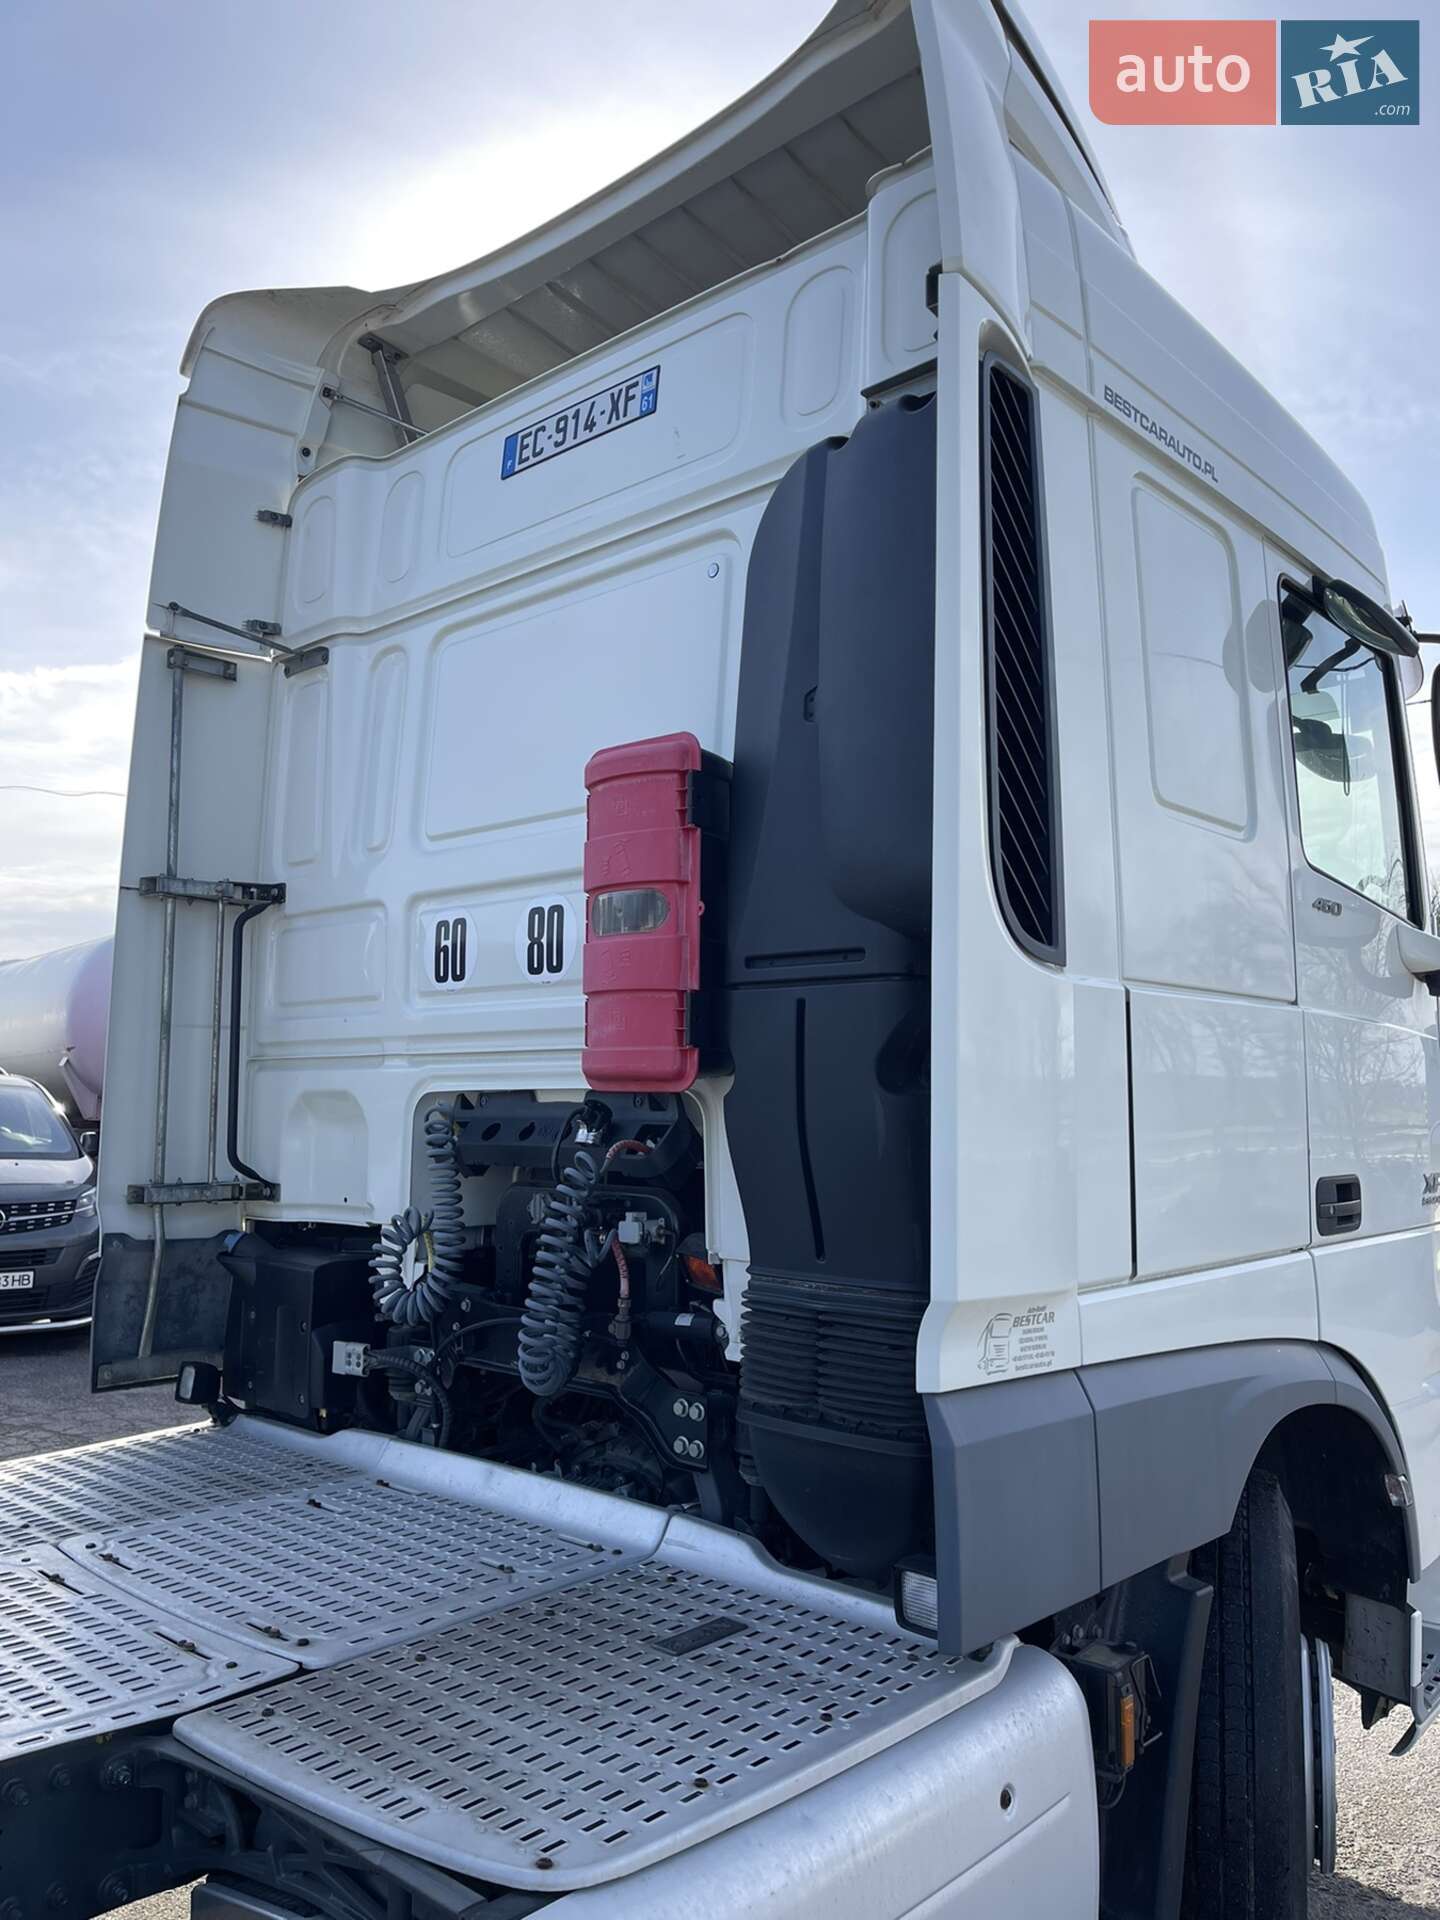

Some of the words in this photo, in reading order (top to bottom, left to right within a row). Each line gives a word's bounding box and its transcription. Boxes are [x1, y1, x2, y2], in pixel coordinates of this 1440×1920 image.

[518, 381, 639, 466] EC-914-XF
[1104, 384, 1218, 484] BESTCARAUTO.PL
[434, 917, 467, 984] 60
[527, 904, 565, 976] 80
[0, 1274, 31, 1287] 3HB
[1012, 1312, 1055, 1328] BESTCAR
